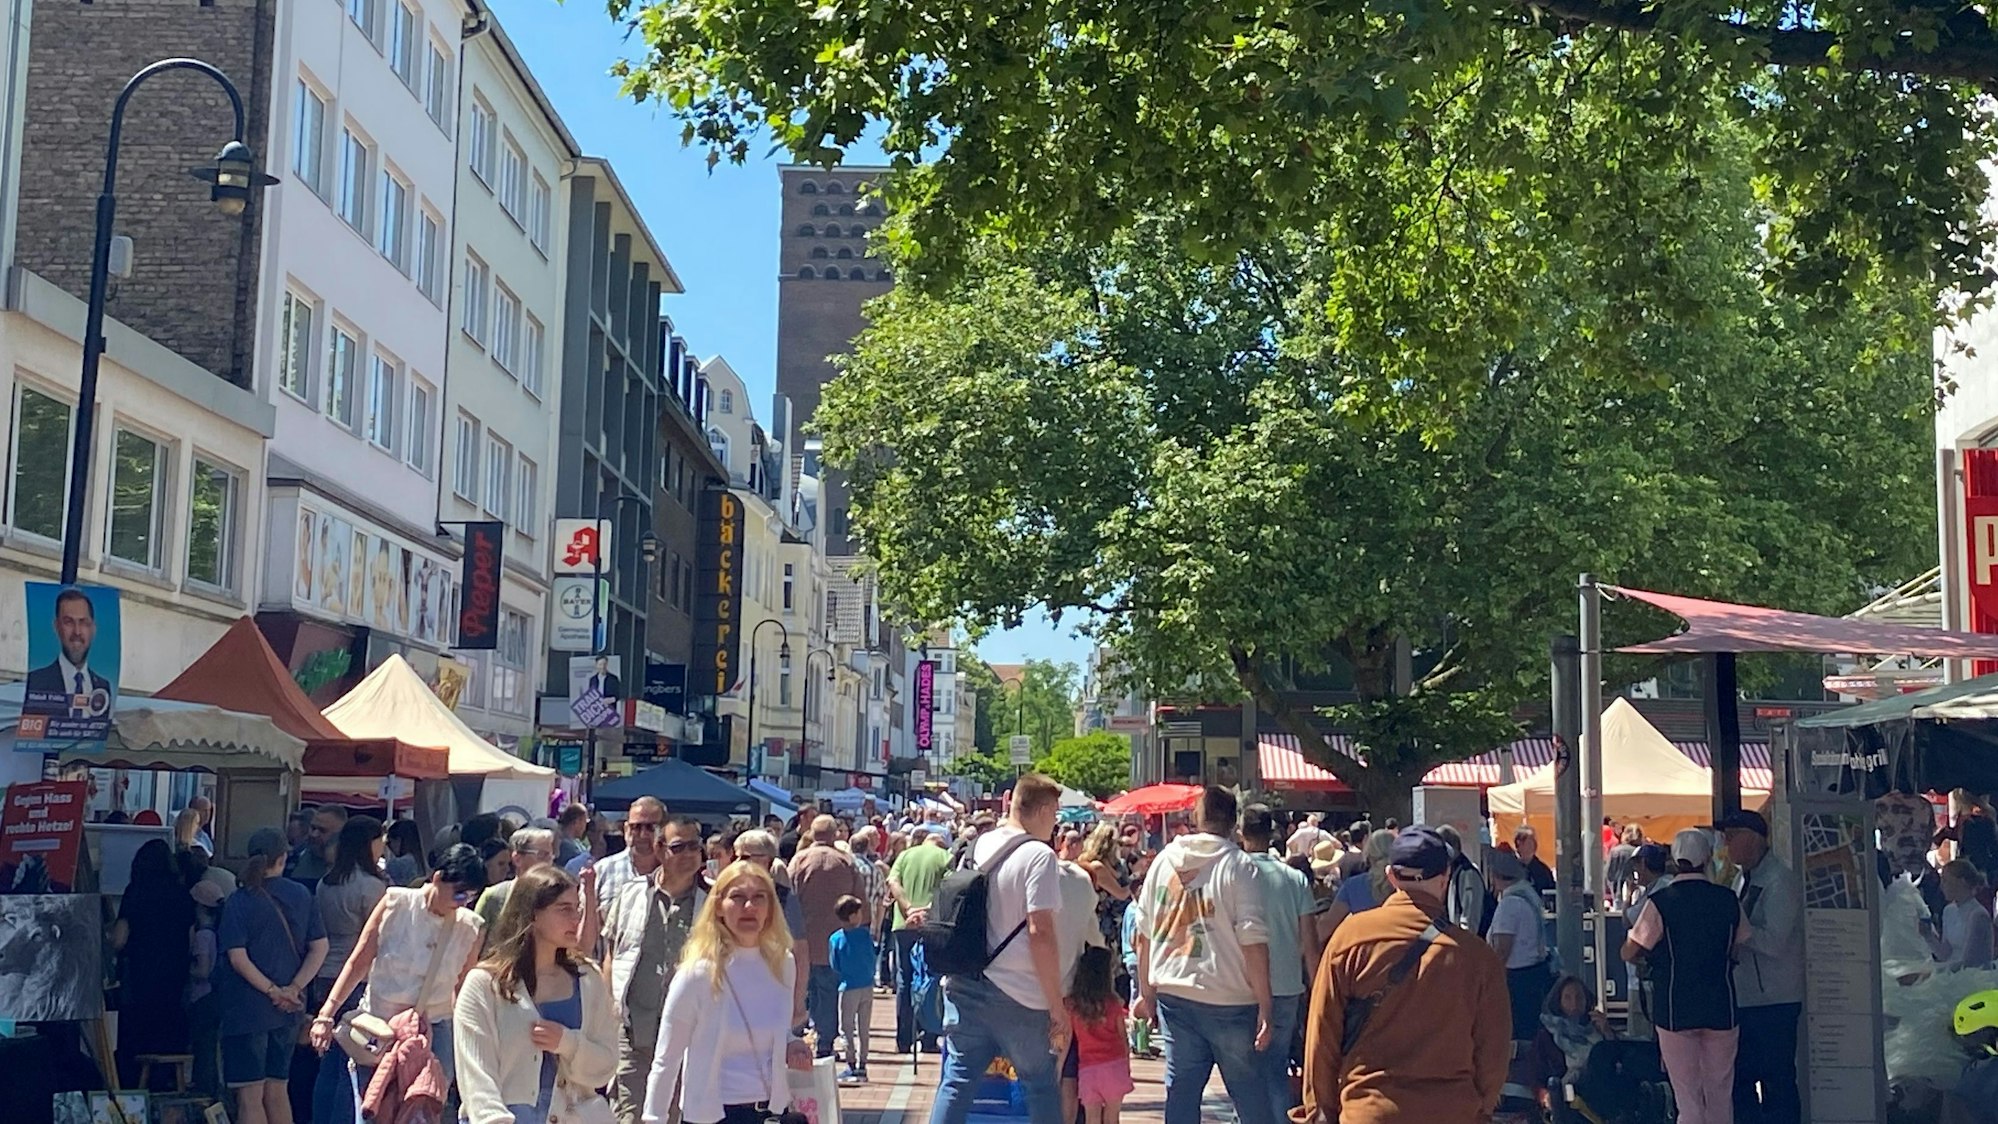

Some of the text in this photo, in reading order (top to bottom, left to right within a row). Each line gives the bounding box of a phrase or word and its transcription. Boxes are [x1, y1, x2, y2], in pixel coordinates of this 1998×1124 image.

[643, 685, 682, 695] ngbers
[573, 688, 600, 714] TRAU
[21, 718, 43, 732] BIG
[14, 793, 73, 808] Gegen Hass
[5, 820, 74, 834] rechte Hetze!
